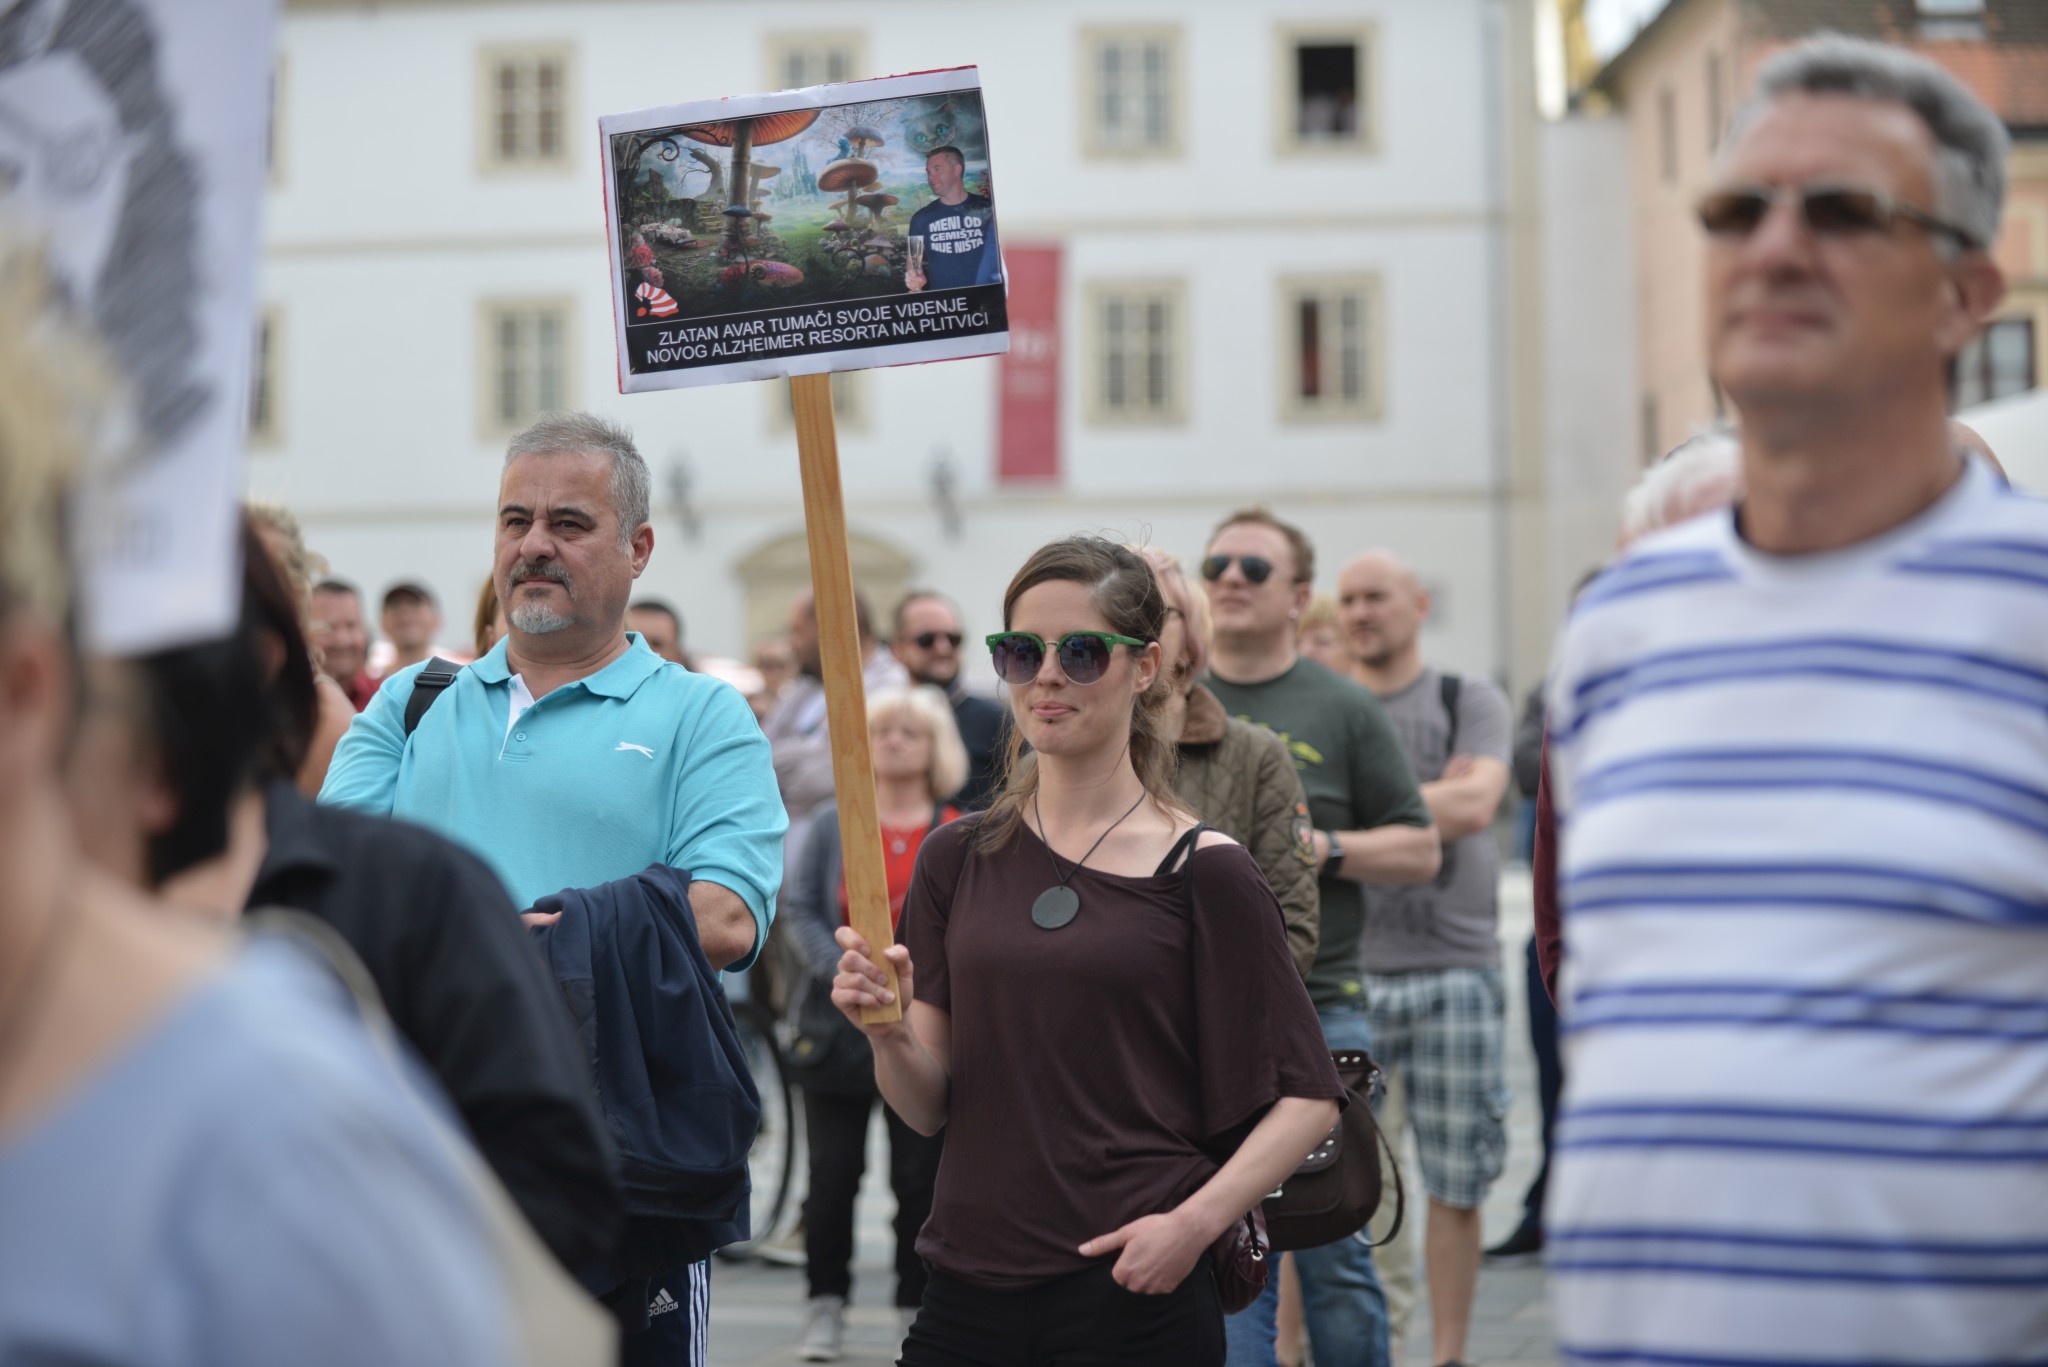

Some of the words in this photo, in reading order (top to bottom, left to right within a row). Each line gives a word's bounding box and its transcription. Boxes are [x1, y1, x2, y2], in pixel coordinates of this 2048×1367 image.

[929, 216, 961, 232] MENI
[964, 216, 982, 228] OD
[647, 345, 708, 364] NOVOG
[712, 331, 804, 357] ALZHEIMER
[809, 323, 889, 345] RESORTA
[892, 320, 917, 336] NA
[920, 312, 989, 333] PLITVICI
[658, 327, 719, 346] ZLATAN
[722, 320, 765, 339] AVAR
[768, 310, 832, 332] TUMAČI
[836, 305, 891, 324] SVOJE
[895, 297, 968, 317] VIĐENJE
